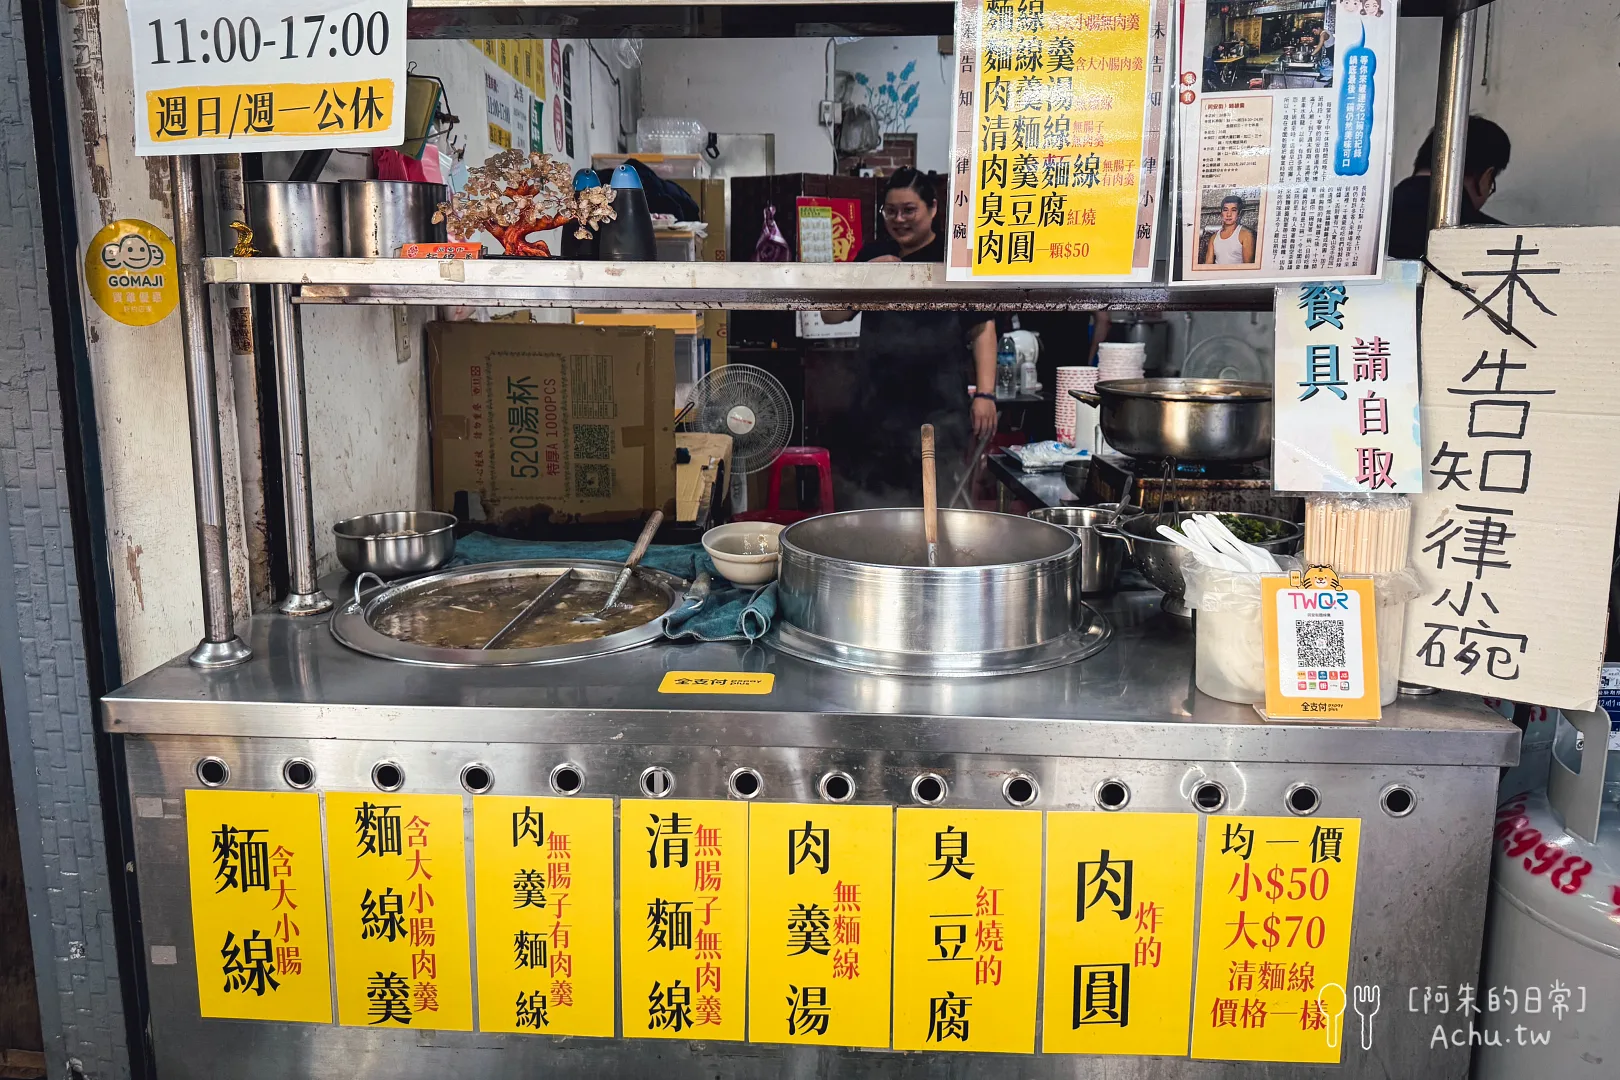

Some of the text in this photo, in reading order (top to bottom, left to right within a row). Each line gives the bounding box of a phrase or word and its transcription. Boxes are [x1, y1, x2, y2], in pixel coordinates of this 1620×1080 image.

[148, 11, 390, 65] 11:00-17:00
[983, 36, 1143, 74] 麵線羹 含大小腸肉羹
[985, 0, 1045, 33] 麵線
[155, 86, 384, 139] 週日/週一公休
[953, 22, 977, 239] 未告知一律小碗
[981, 115, 1104, 151] 清麵線 無腸子
[984, 75, 1074, 113] 肉羹湯
[1137, 21, 1166, 240] 未告知一律小碗
[977, 191, 1097, 228] 臭豆腐 紅燒
[980, 153, 1136, 190] 肉羹麵線 無腸子
[1101, 173, 1135, 187] 有肉羹
[108, 275, 163, 287] GOMAJI
[977, 229, 1035, 265] 肉圓
[1296, 281, 1349, 402] 餐具
[506, 375, 540, 479] 520湯杯
[543, 378, 561, 476] 特厚A 1000PCS
[1351, 335, 1397, 490] 請自取
[1416, 234, 1560, 680] 未告知一律小碗
[1287, 592, 1349, 610] TWQR
[674, 677, 727, 685] 全支付
[1301, 701, 1327, 712] 全支付
[1221, 822, 1344, 863] 均一價
[1228, 862, 1329, 904] 小$50
[211, 823, 280, 996] 麵線
[269, 844, 302, 977] 含大小腸
[354, 801, 413, 1025] 麵線羹
[403, 814, 439, 1013] 含大小腸肉羹
[512, 805, 550, 1030] 肉羹麵線
[546, 830, 574, 1008] 無腸子有肉羹
[646, 812, 694, 1033] 清麵線
[694, 823, 723, 1026] 無腸子無肉羹
[786, 820, 832, 1036] 肉羹湯
[832, 879, 861, 980] 無麵線
[925, 825, 975, 1044] 臭豆腐
[974, 886, 1004, 987] 紅燒的
[1071, 848, 1134, 1030] 肉圓
[1134, 900, 1164, 969] 炸的
[1223, 911, 1326, 952] 大$70
[1210, 997, 1328, 1031] 價格一樣
[1228, 959, 1315, 993] 清麵線
